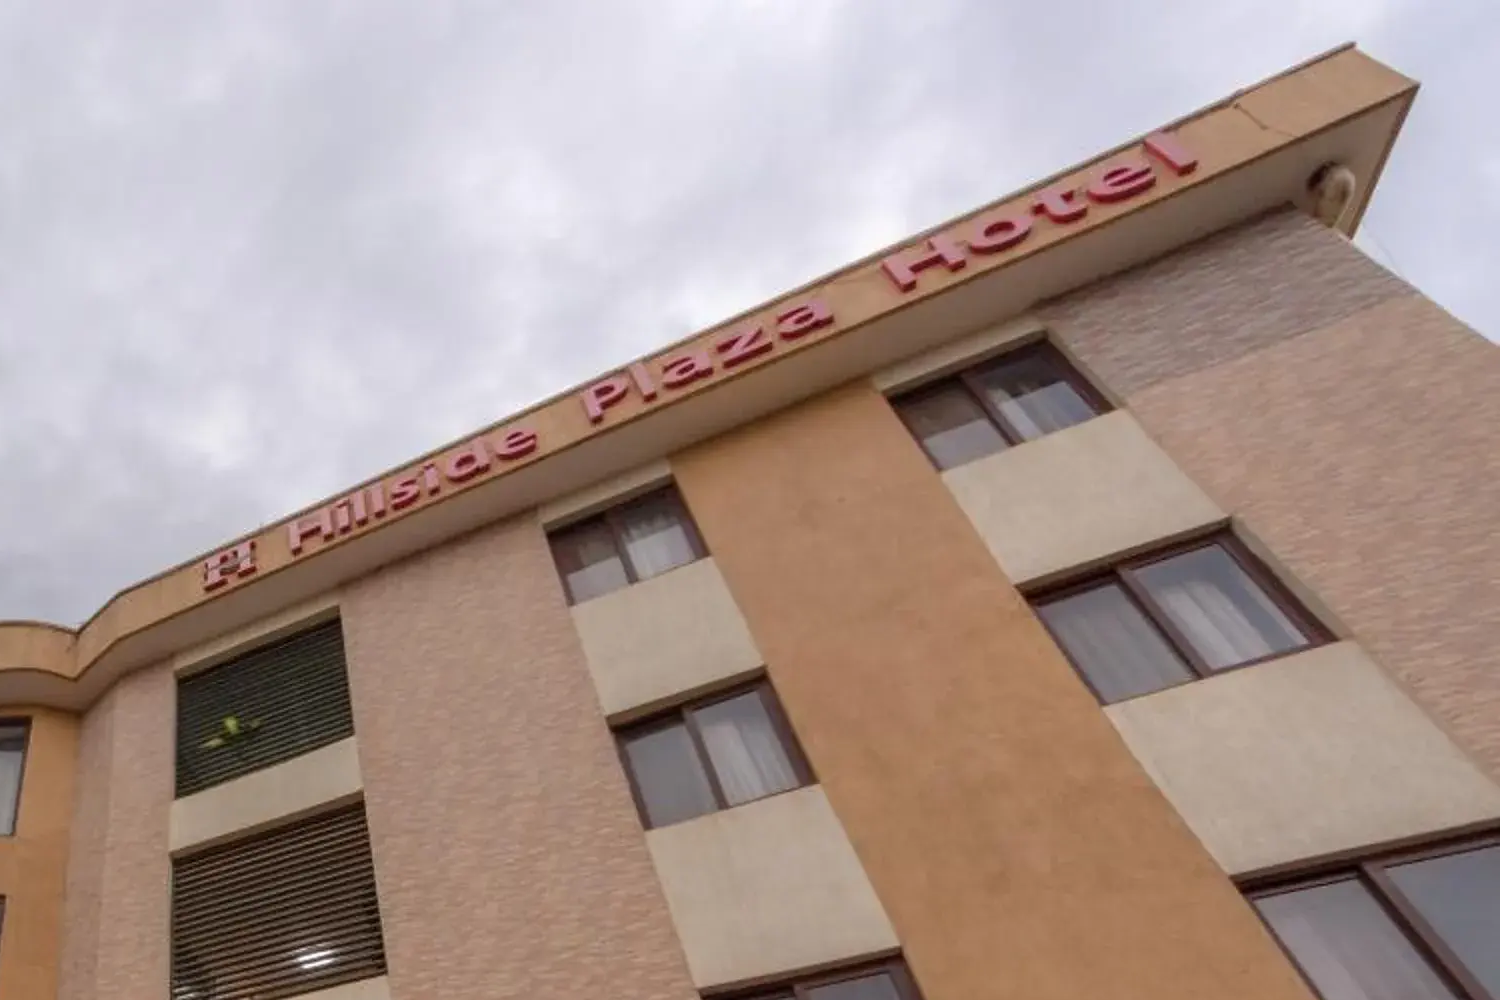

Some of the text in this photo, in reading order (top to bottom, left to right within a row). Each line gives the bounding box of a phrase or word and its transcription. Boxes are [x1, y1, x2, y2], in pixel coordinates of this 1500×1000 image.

[286, 421, 538, 557] Hillside
[580, 299, 835, 424] Plaza
[882, 128, 1198, 293] Hotel
